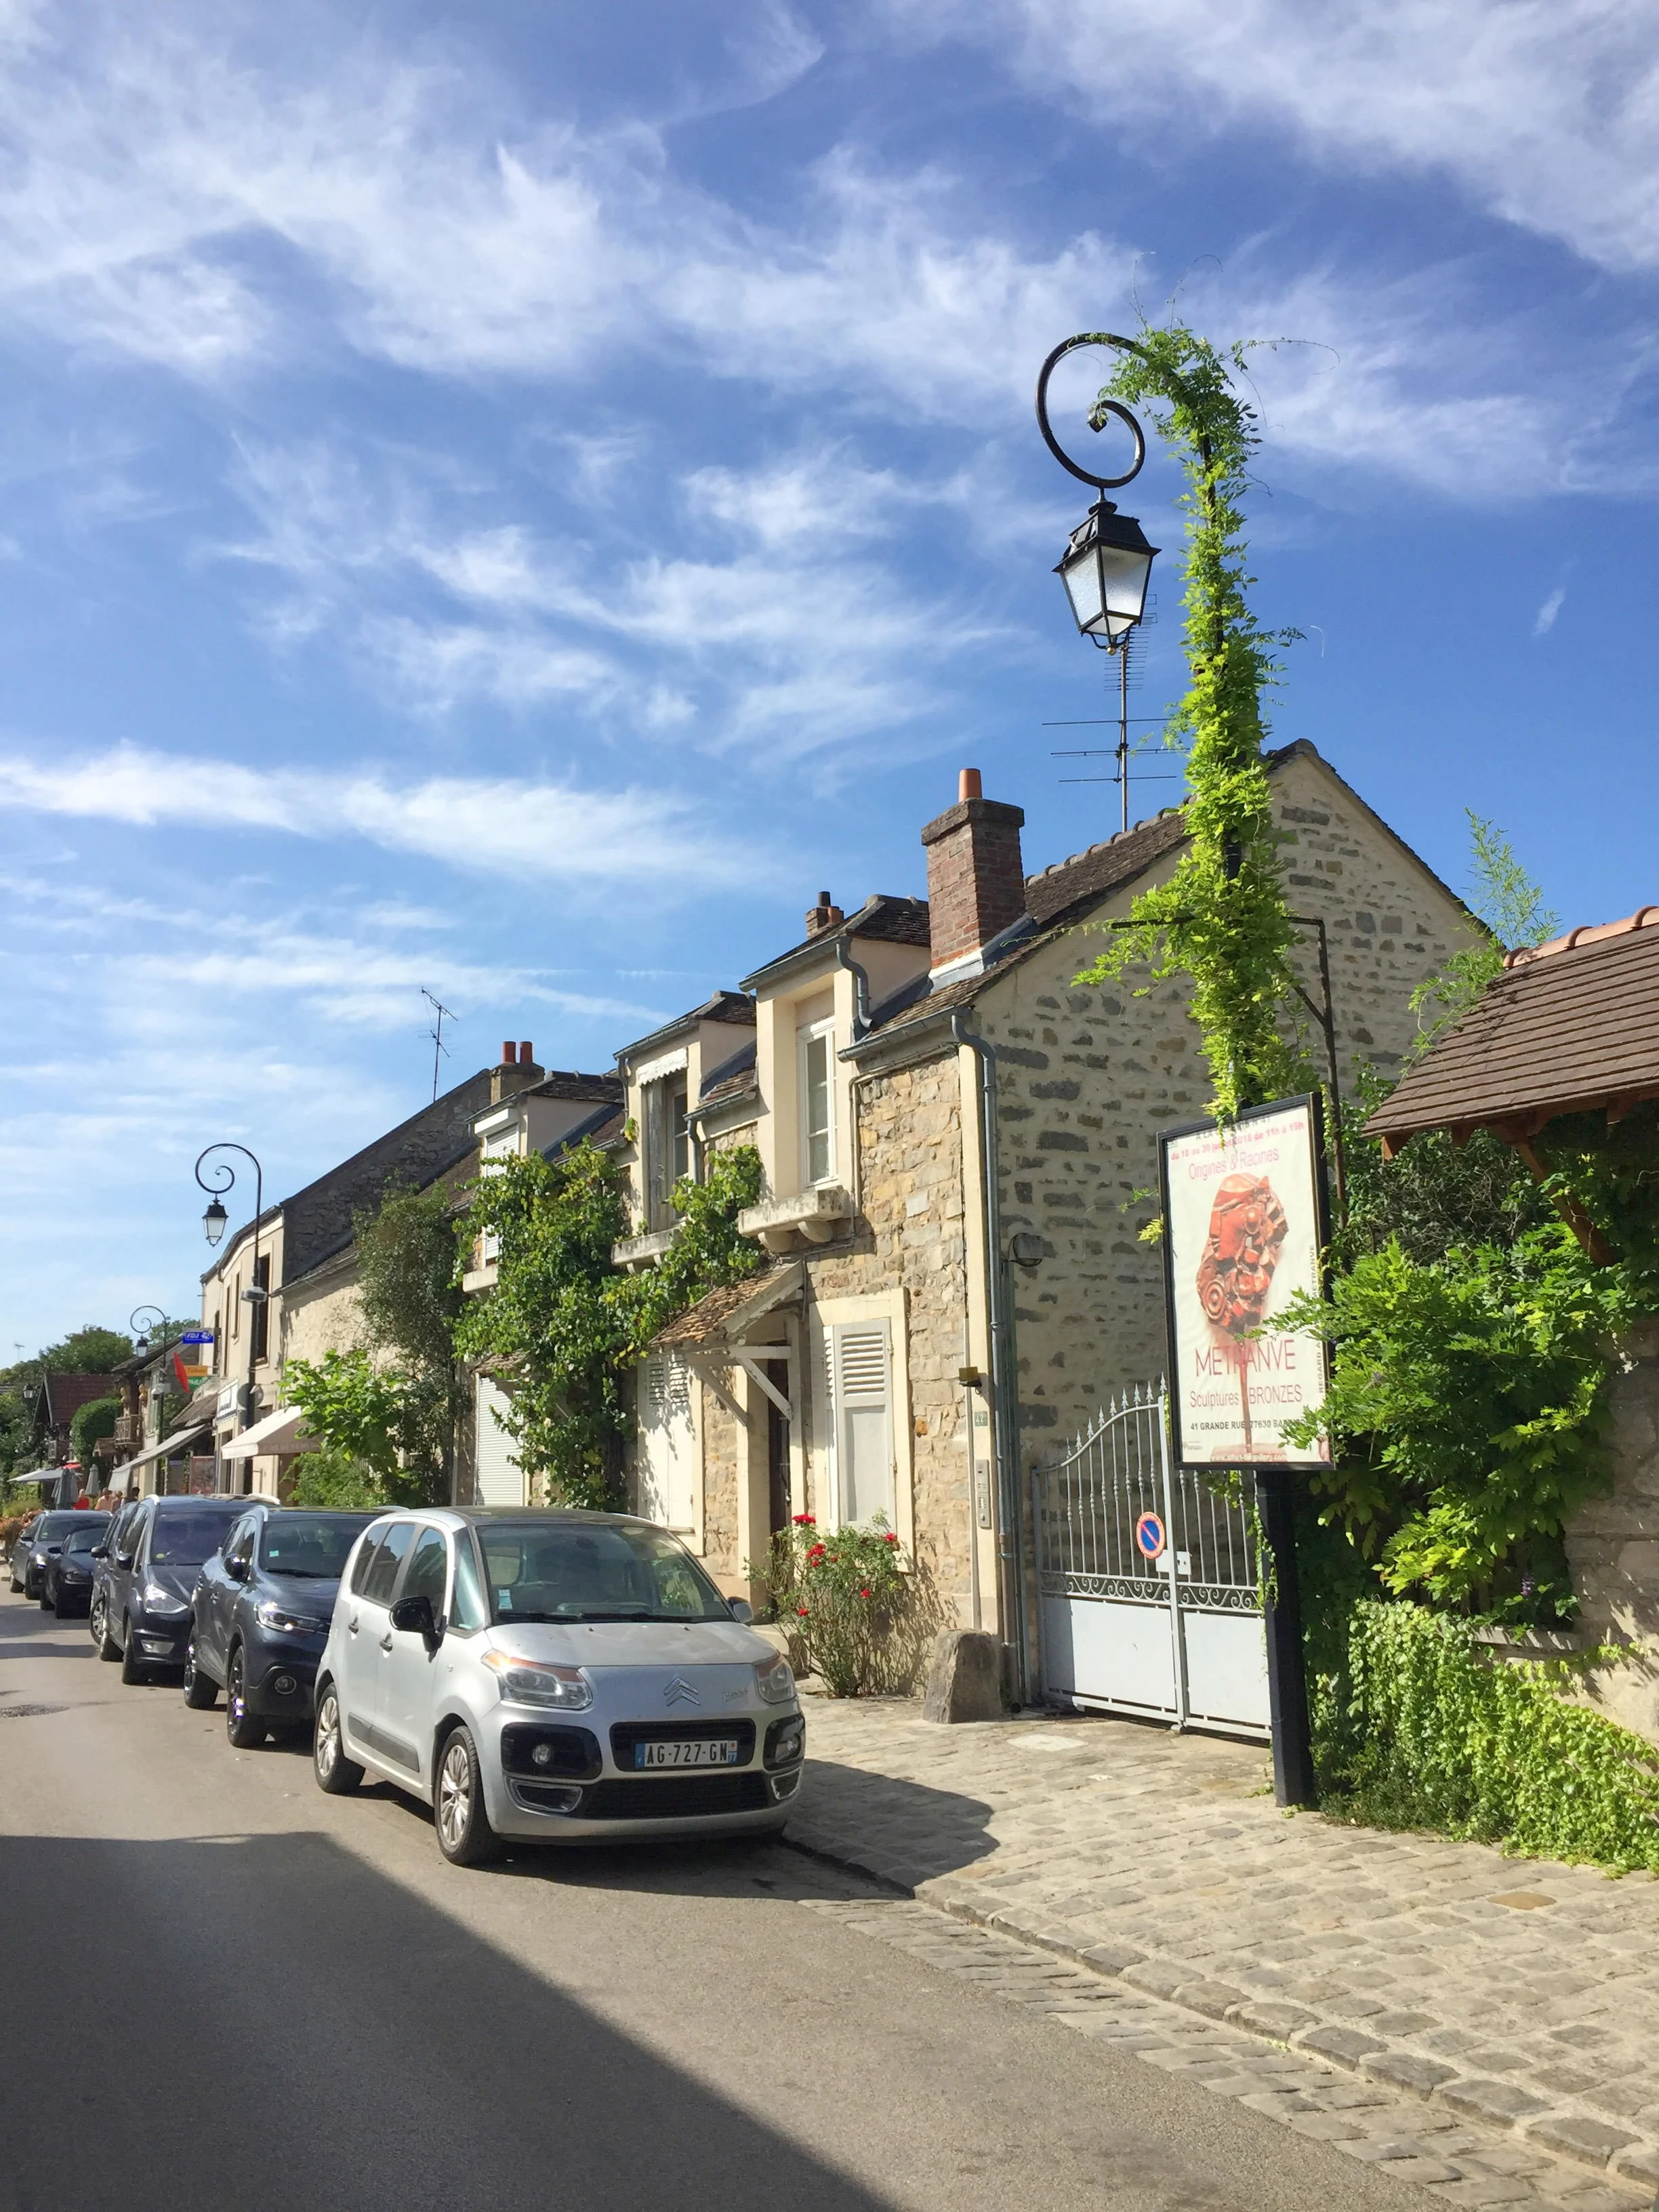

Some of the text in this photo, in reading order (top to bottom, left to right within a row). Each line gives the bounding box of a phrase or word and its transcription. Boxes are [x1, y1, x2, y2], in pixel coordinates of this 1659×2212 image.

[1254, 1132, 1263, 1140] de
[1189, 1148, 1279, 1181] Origines & Racines
[1190, 1384, 1303, 1410] Sculptures BRONZES
[1190, 1422, 1198, 1431] 41
[1200, 1420, 1229, 1431] GRANDE
[1231, 1420, 1245, 1429] RUE
[729, 1752, 737, 1763] 77
